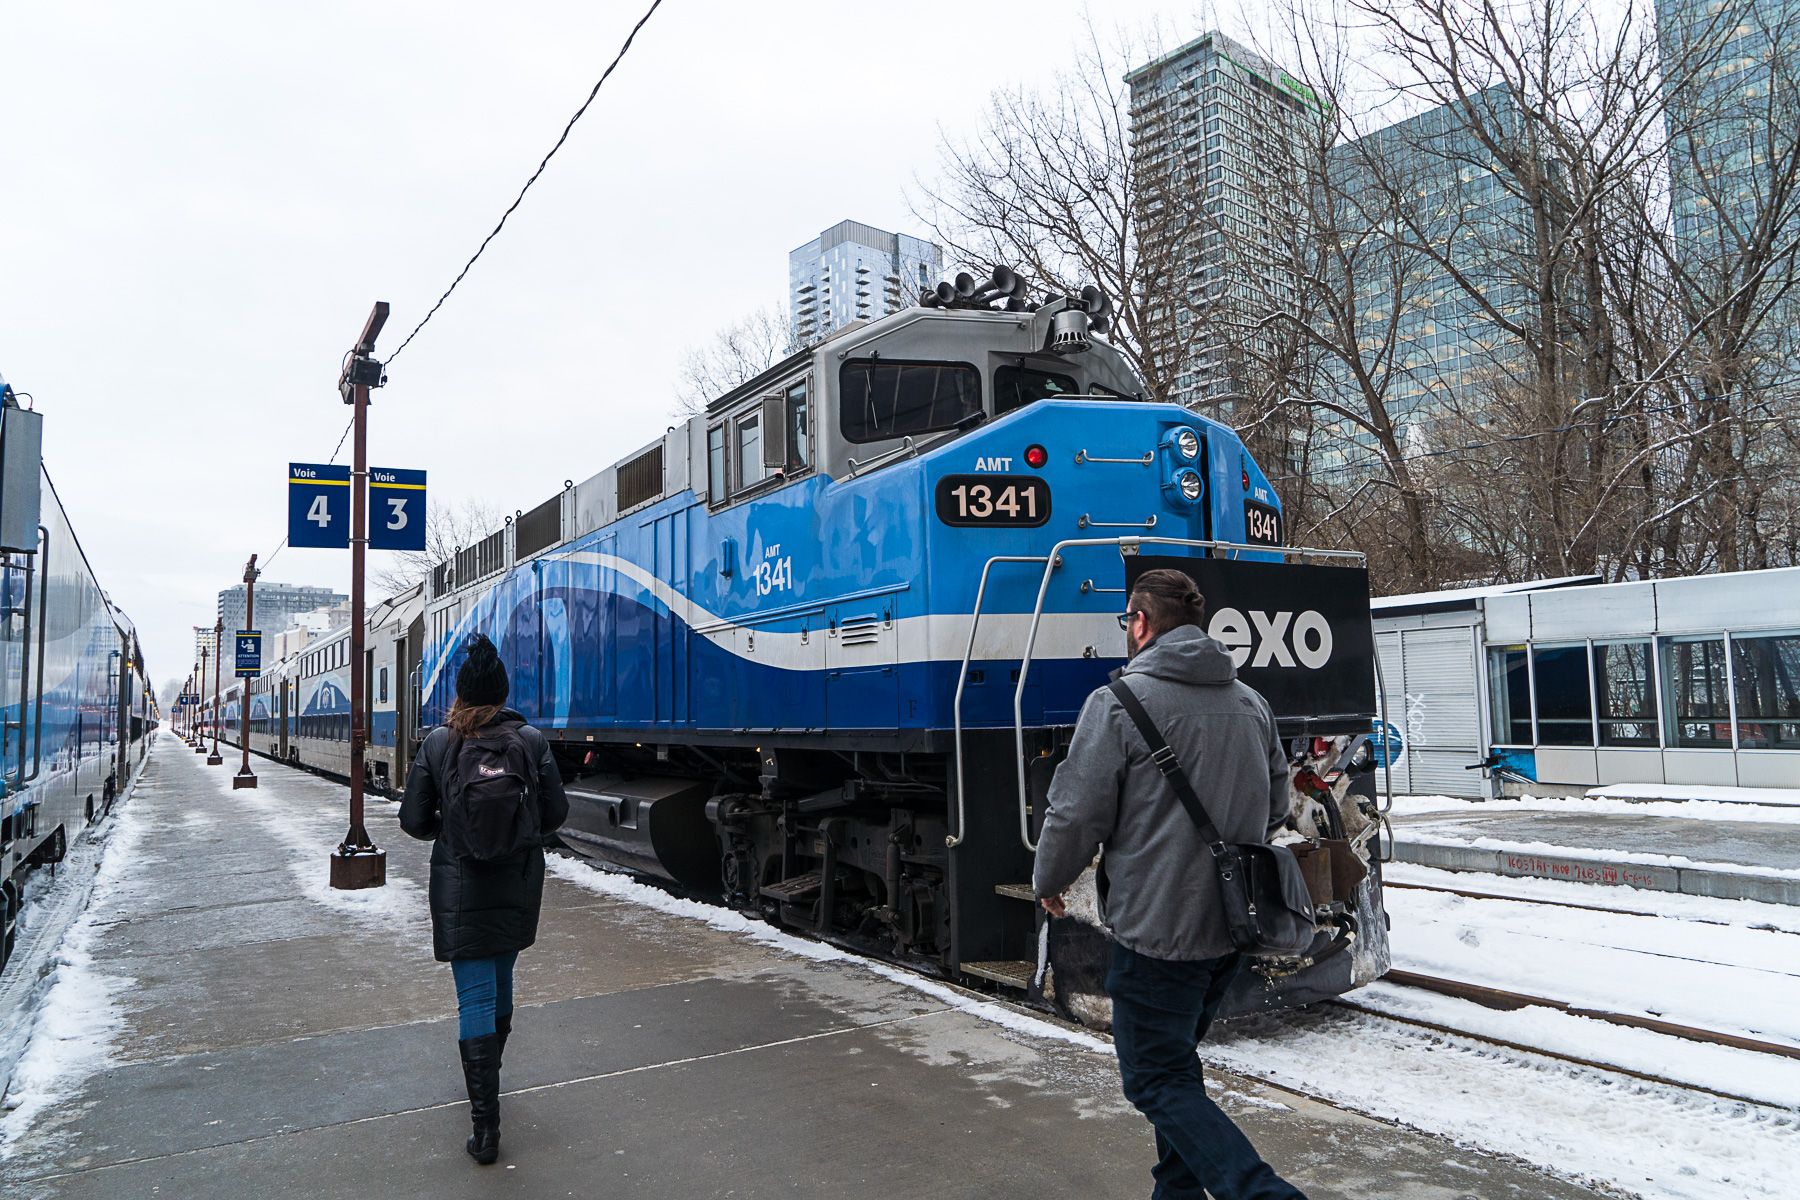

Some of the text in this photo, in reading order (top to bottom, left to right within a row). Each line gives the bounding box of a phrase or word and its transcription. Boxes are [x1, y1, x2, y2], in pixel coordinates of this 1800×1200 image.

[294, 468, 316, 478] Voie
[975, 457, 1012, 471] AMT
[374, 472, 396, 482] Voie
[951, 484, 1036, 517] 1341
[1254, 487, 1268, 501] AMT
[307, 495, 332, 527] 4
[386, 498, 408, 530] 3
[1248, 508, 1278, 542] 1341
[765, 543, 780, 559] AMT
[753, 556, 792, 596] 1341
[1207, 607, 1333, 669] exo
[909, 699, 917, 718] F
